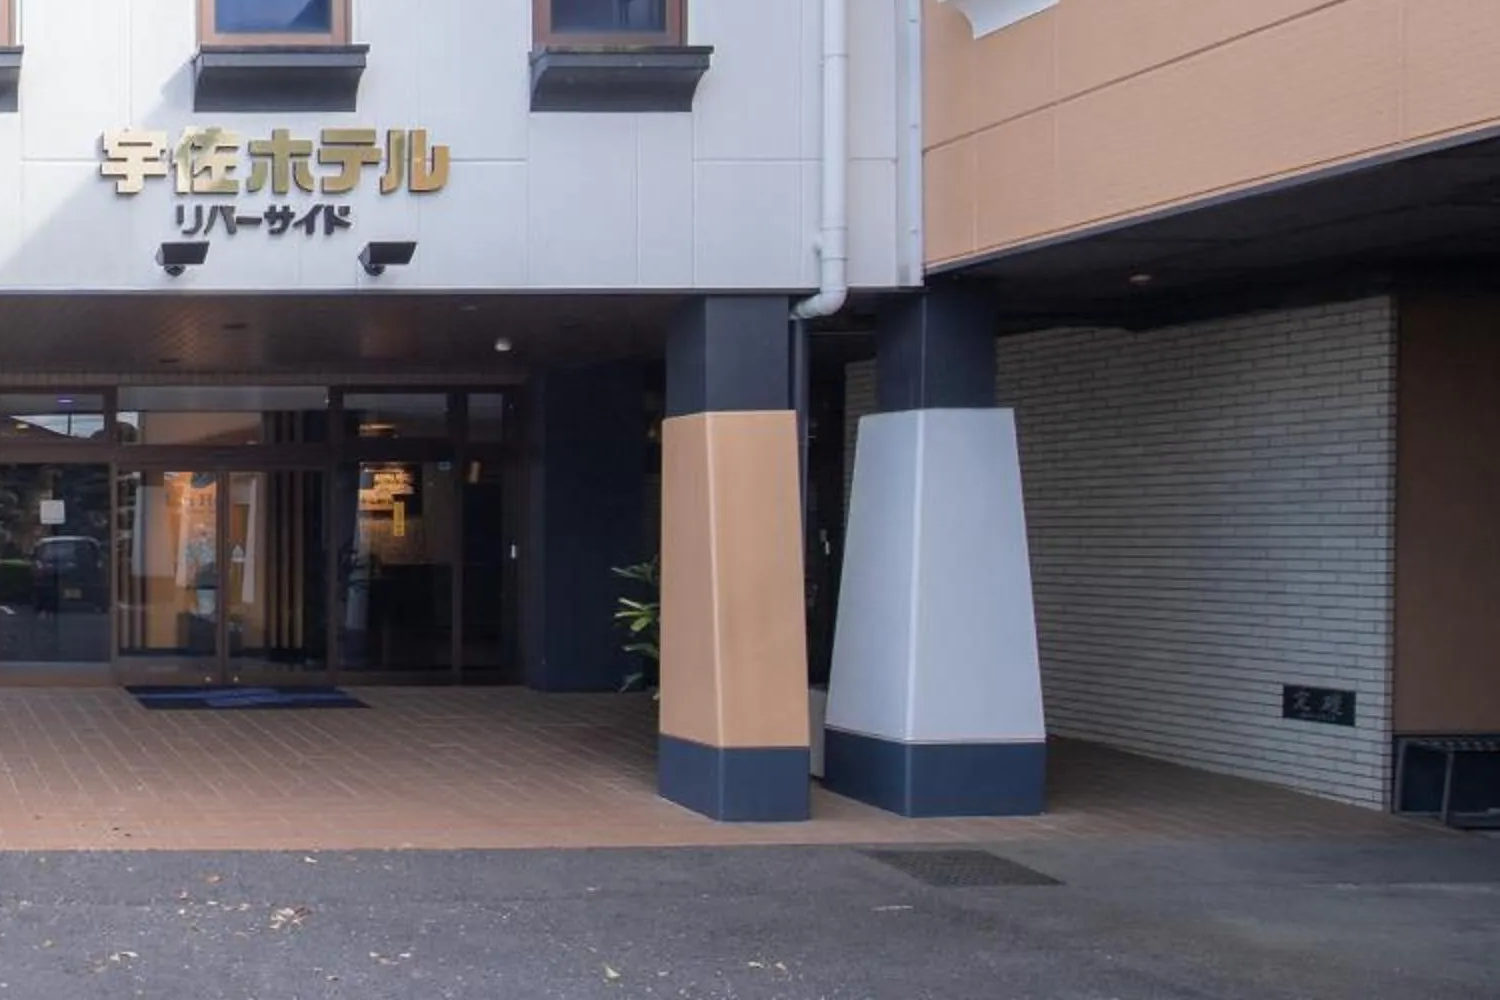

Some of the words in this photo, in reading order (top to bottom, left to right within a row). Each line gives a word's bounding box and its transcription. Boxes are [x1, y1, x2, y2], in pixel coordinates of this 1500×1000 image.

[100, 127, 450, 194] 宇佐ホテル
[176, 203, 352, 236] リバーサイド
